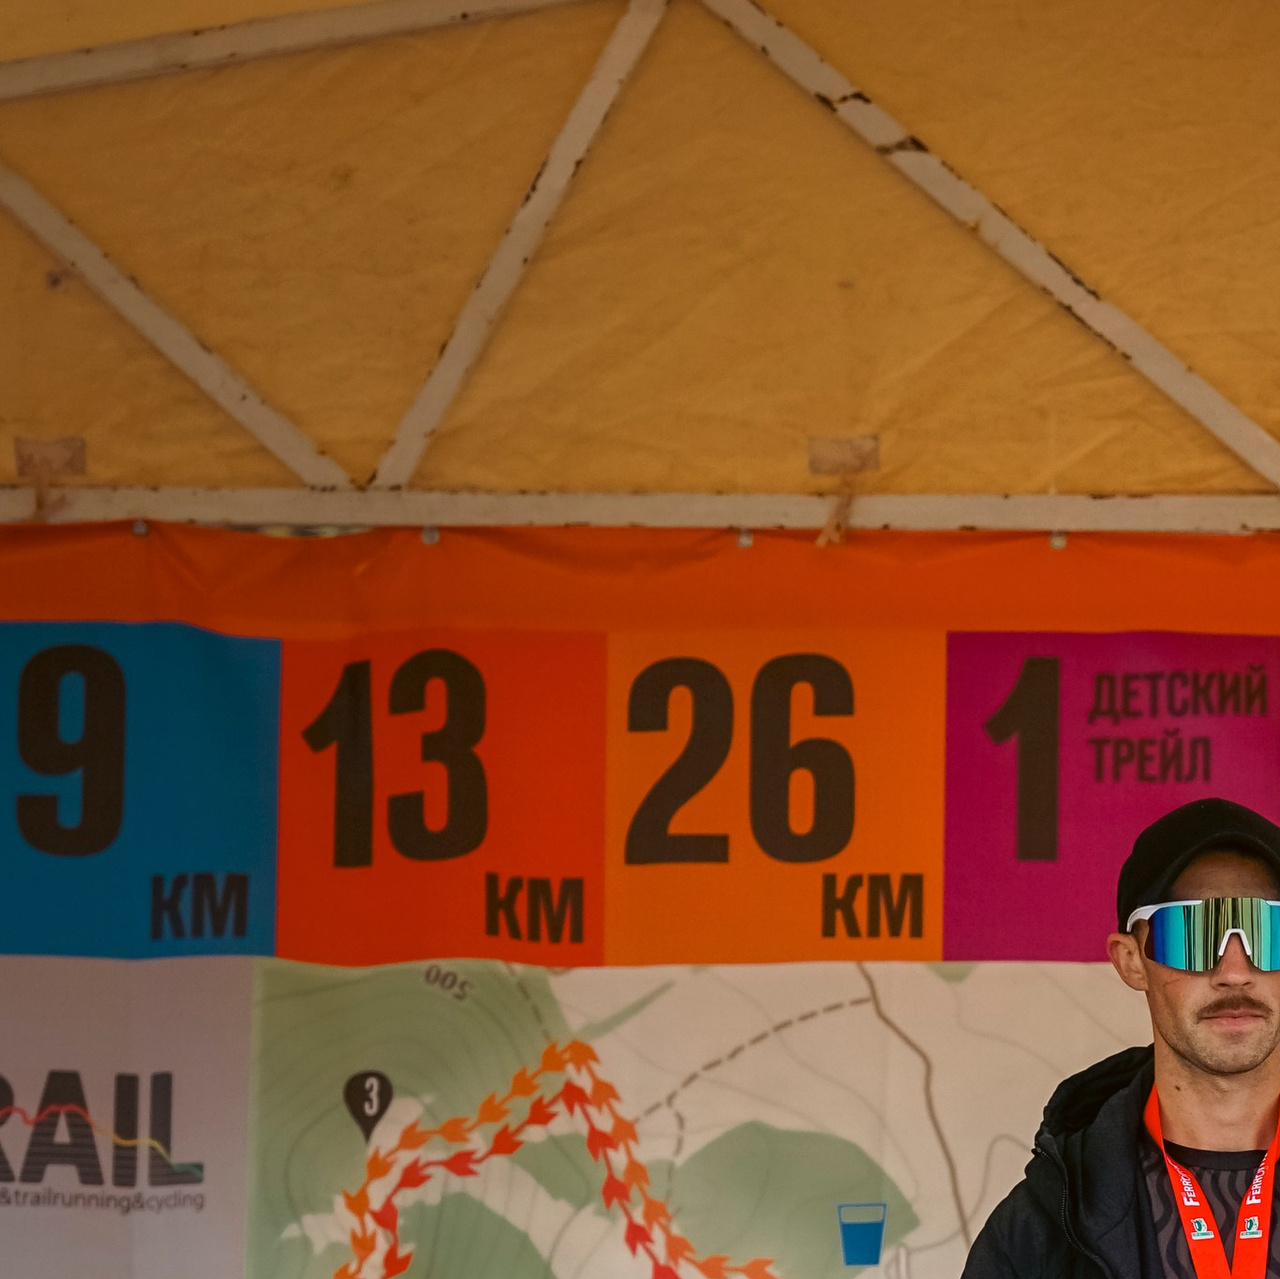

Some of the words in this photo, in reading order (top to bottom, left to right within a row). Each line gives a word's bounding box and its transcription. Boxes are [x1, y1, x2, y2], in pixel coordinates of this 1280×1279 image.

[1088, 663, 1269, 724] ДЕТСКИЙ
[16, 643, 127, 858] 9
[302, 648, 488, 868] 13
[624, 653, 856, 865] 26
[984, 656, 1061, 861] 1
[1088, 727, 1211, 785] ТРЕЙЛ
[150, 871, 249, 942] КМ
[485, 872, 584, 944] КМ
[822, 873, 924, 939] КМ
[0, 1069, 204, 1188] AIL
[365, 1078, 380, 1116] 3
